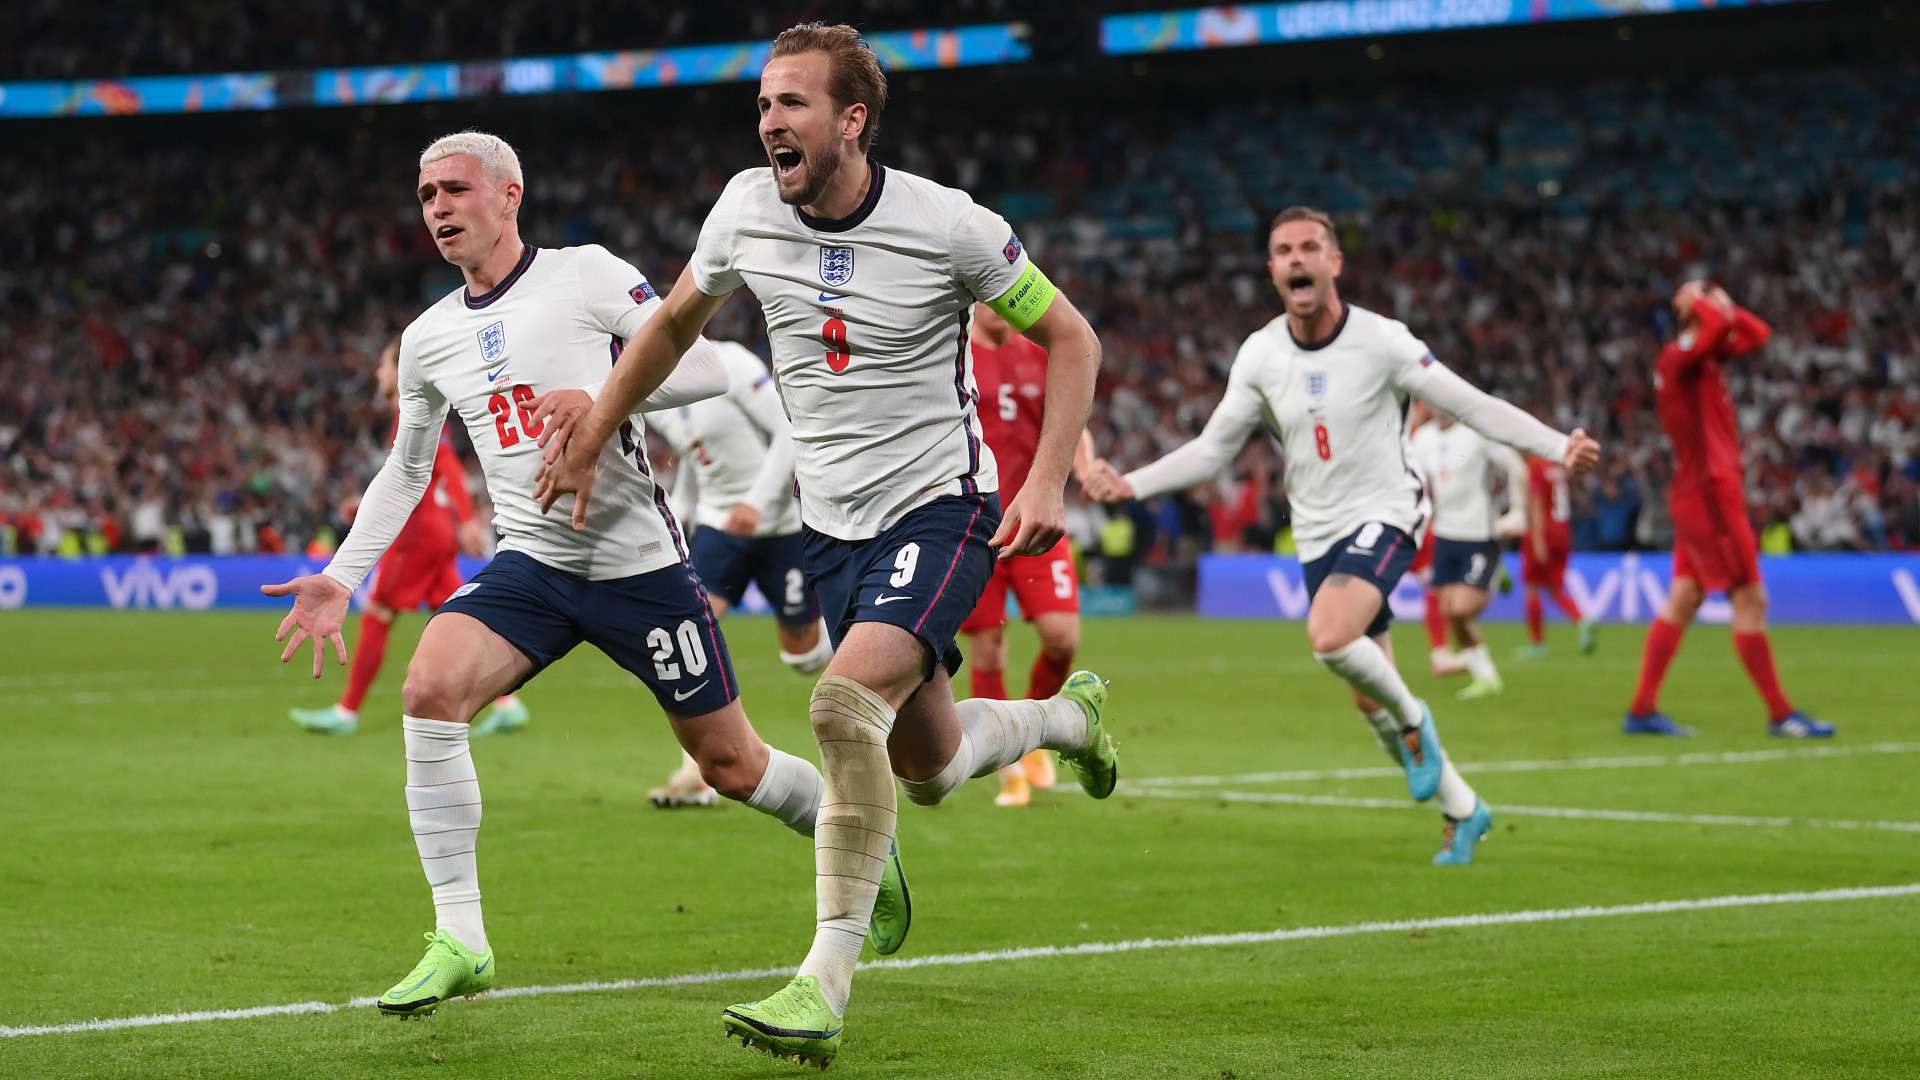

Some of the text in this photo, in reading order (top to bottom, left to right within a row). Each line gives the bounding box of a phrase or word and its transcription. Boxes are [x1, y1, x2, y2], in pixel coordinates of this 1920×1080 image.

[822, 317, 851, 372] 9
[999, 383, 1018, 421] 5
[1315, 424, 1332, 461] 8
[889, 542, 920, 588] 9
[1051, 560, 1073, 599] 5
[784, 568, 804, 604] 2
[646, 620, 708, 681] 20
